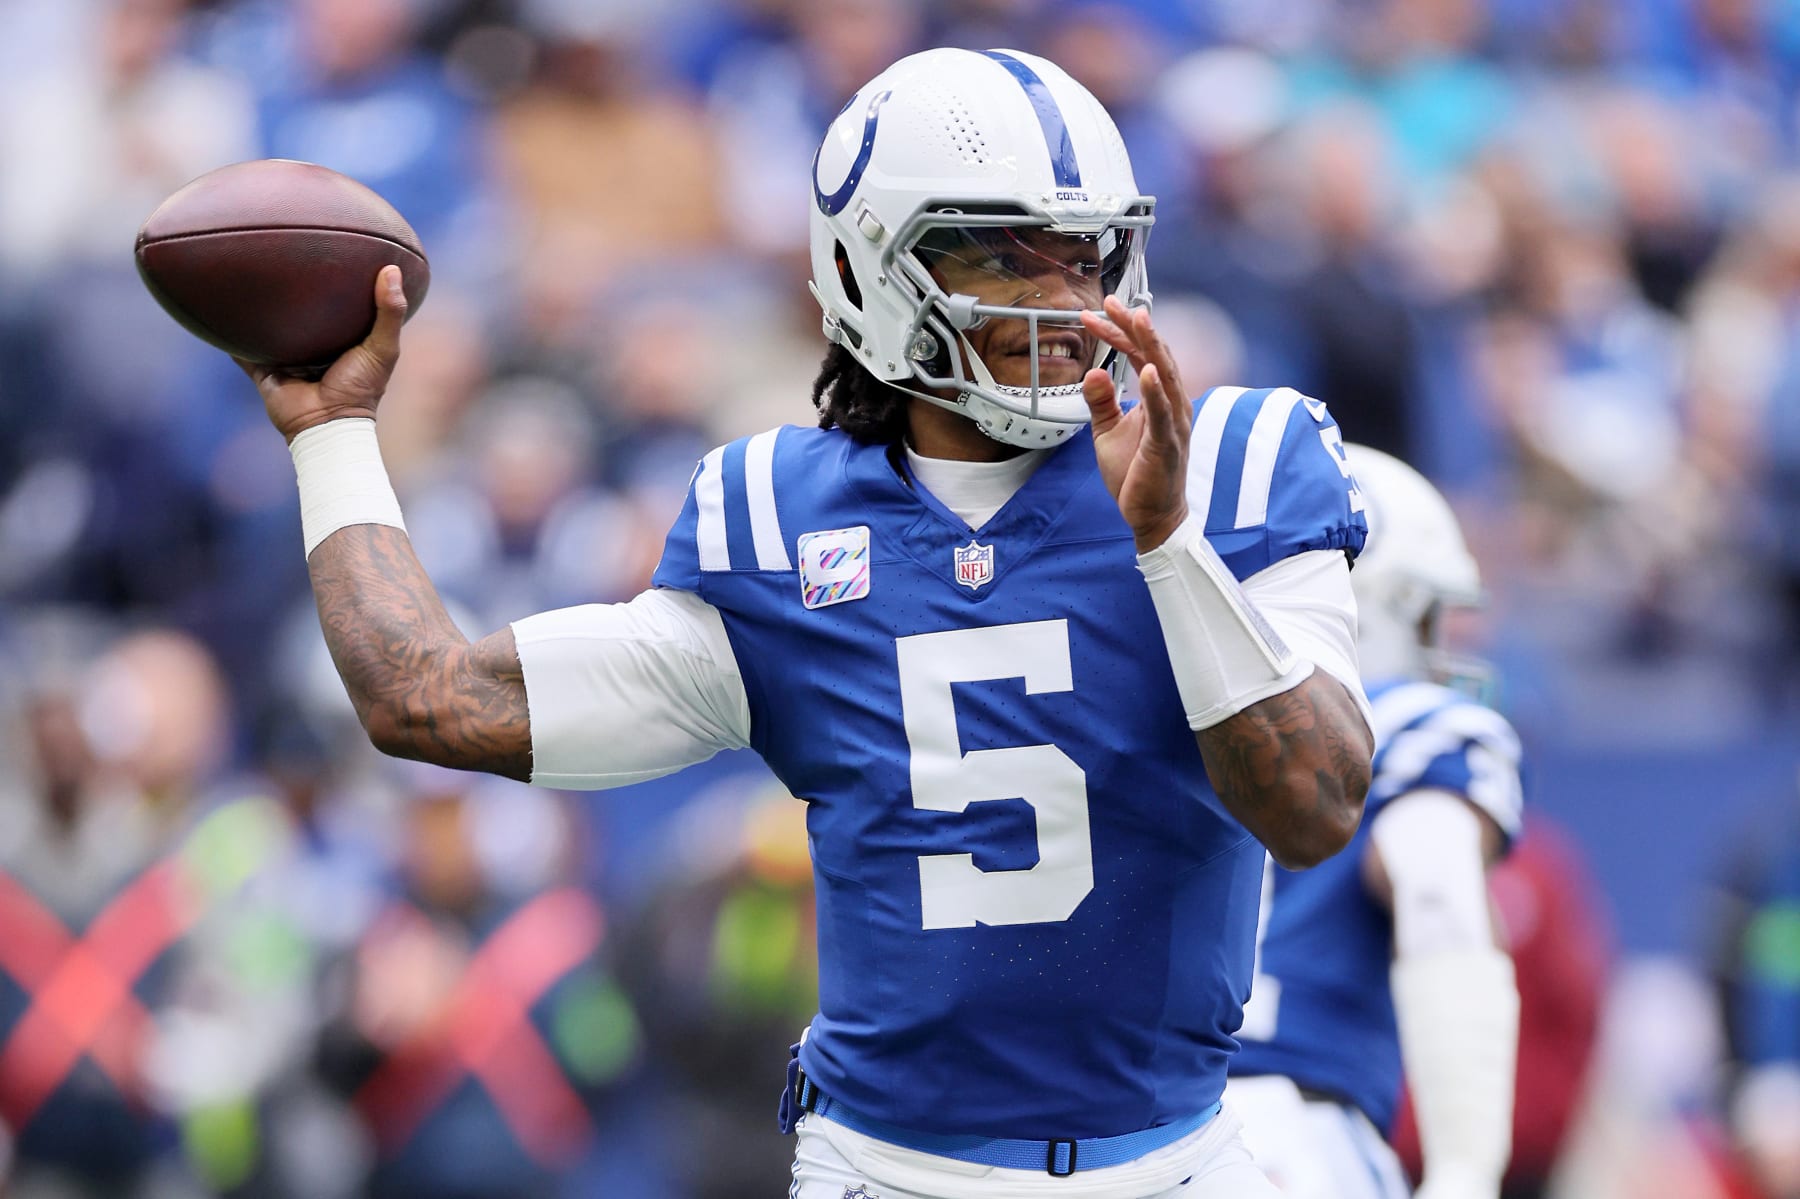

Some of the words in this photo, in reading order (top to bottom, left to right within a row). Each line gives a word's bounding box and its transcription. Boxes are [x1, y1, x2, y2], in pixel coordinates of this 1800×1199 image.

[1056, 192, 1088, 202] COLTS
[961, 562, 987, 580] NFL
[895, 618, 1095, 931] 5
